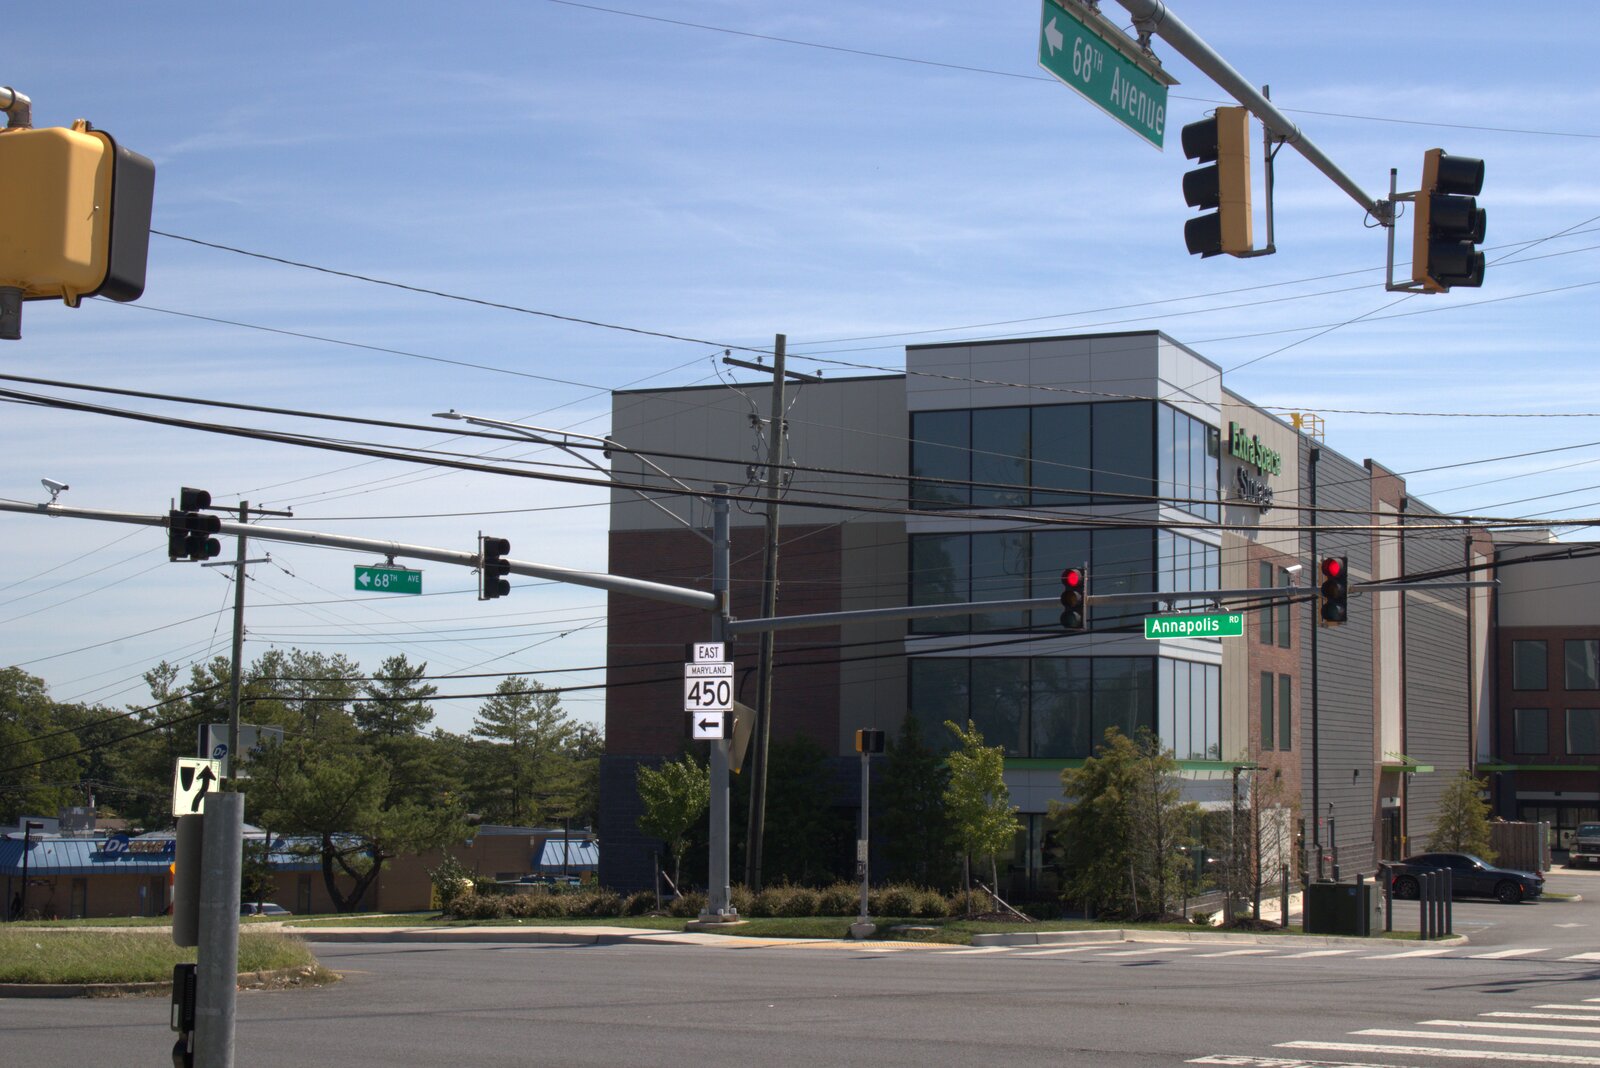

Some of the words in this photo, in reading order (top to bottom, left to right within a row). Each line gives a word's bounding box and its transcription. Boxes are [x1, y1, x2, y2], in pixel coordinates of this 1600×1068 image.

[1073, 36, 1103, 83] 68TH
[1110, 66, 1164, 135] Avenue
[1229, 421, 1255, 464] Extra
[1254, 435, 1281, 476] Space
[374, 573, 398, 588] 68TH
[407, 574, 420, 583] AVE
[1152, 617, 1220, 635] Annapolis
[1229, 615, 1240, 623] RD
[699, 646, 719, 659] EAST
[691, 666, 727, 674] MARYLAND
[687, 680, 731, 706] 450
[105, 839, 127, 852] Dr
